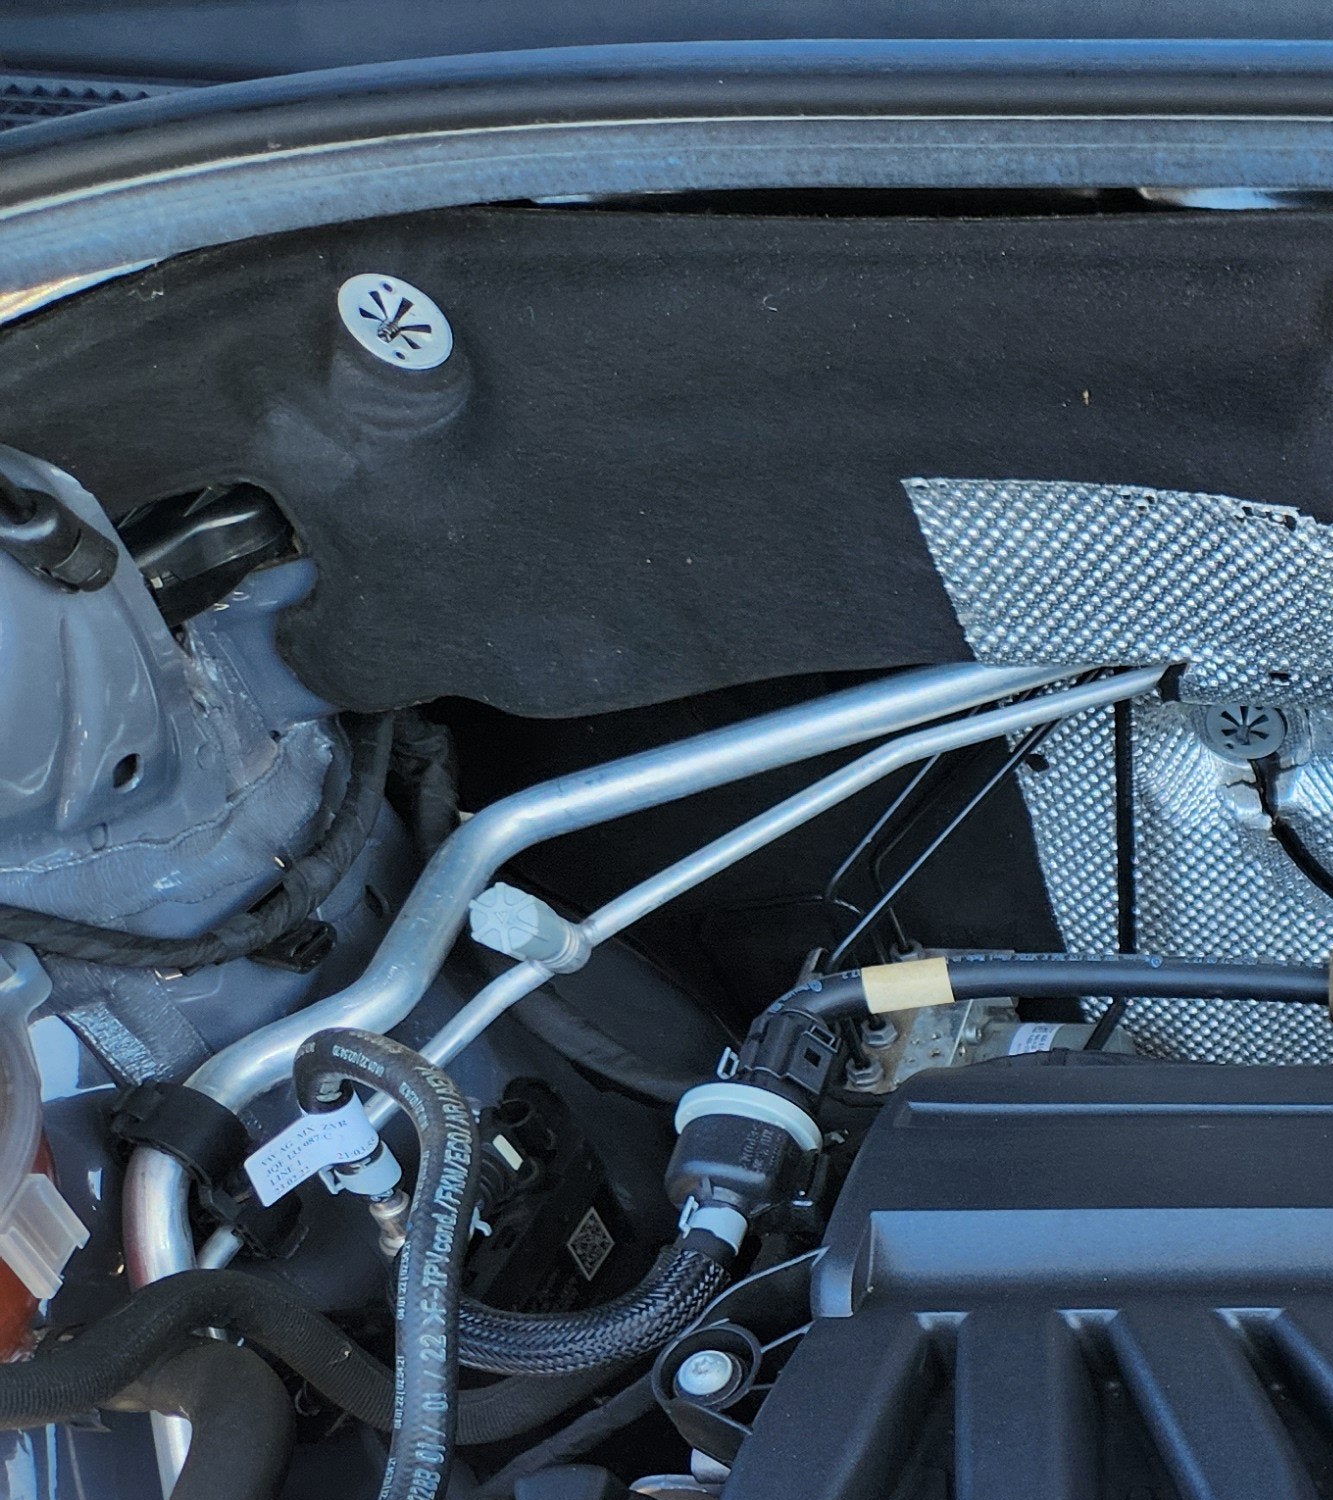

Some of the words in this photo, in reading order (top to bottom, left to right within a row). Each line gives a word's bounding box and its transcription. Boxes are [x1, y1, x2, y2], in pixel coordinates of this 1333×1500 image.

[420, 1334, 447, 1363] 22
[421, 1392, 449, 1413] 01
[415, 1441, 446, 1464] 01
